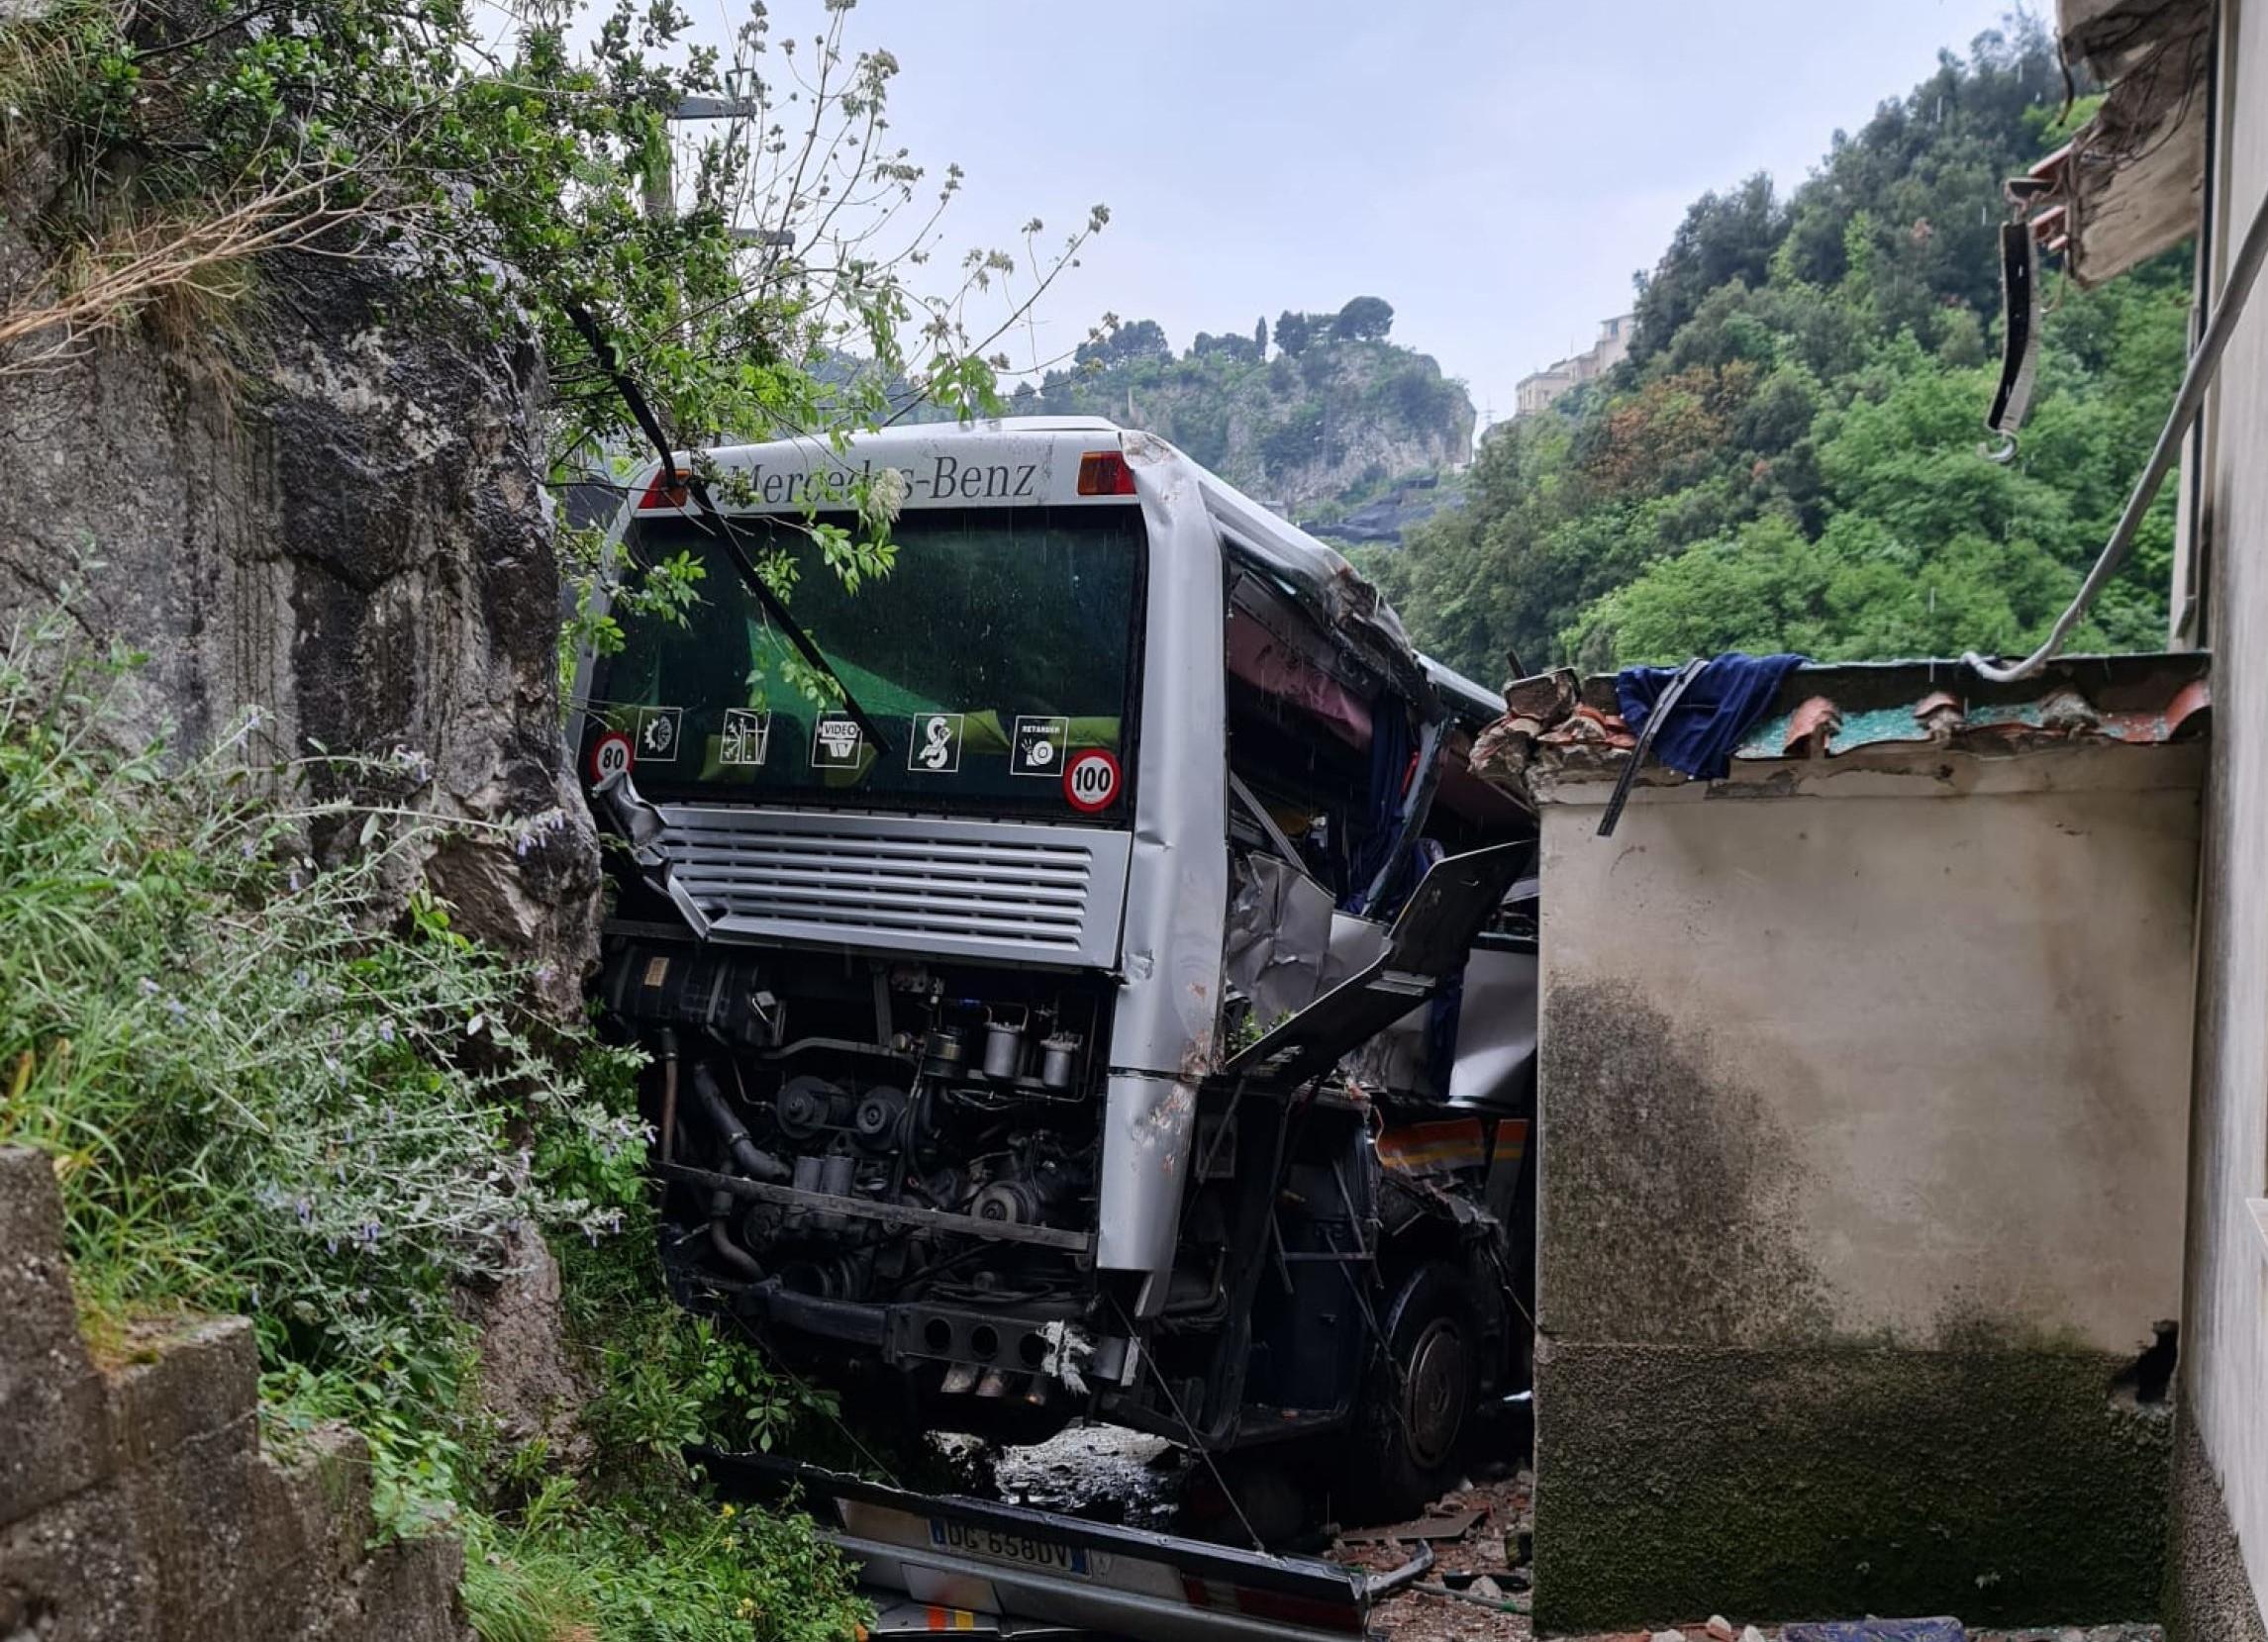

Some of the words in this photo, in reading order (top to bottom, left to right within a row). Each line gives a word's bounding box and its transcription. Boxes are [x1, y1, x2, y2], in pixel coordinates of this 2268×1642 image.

[717, 456, 1036, 504] Merceds-Benz
[825, 724, 857, 735] VIDEO
[602, 746, 625, 770] 80
[1076, 767, 1111, 792] 100
